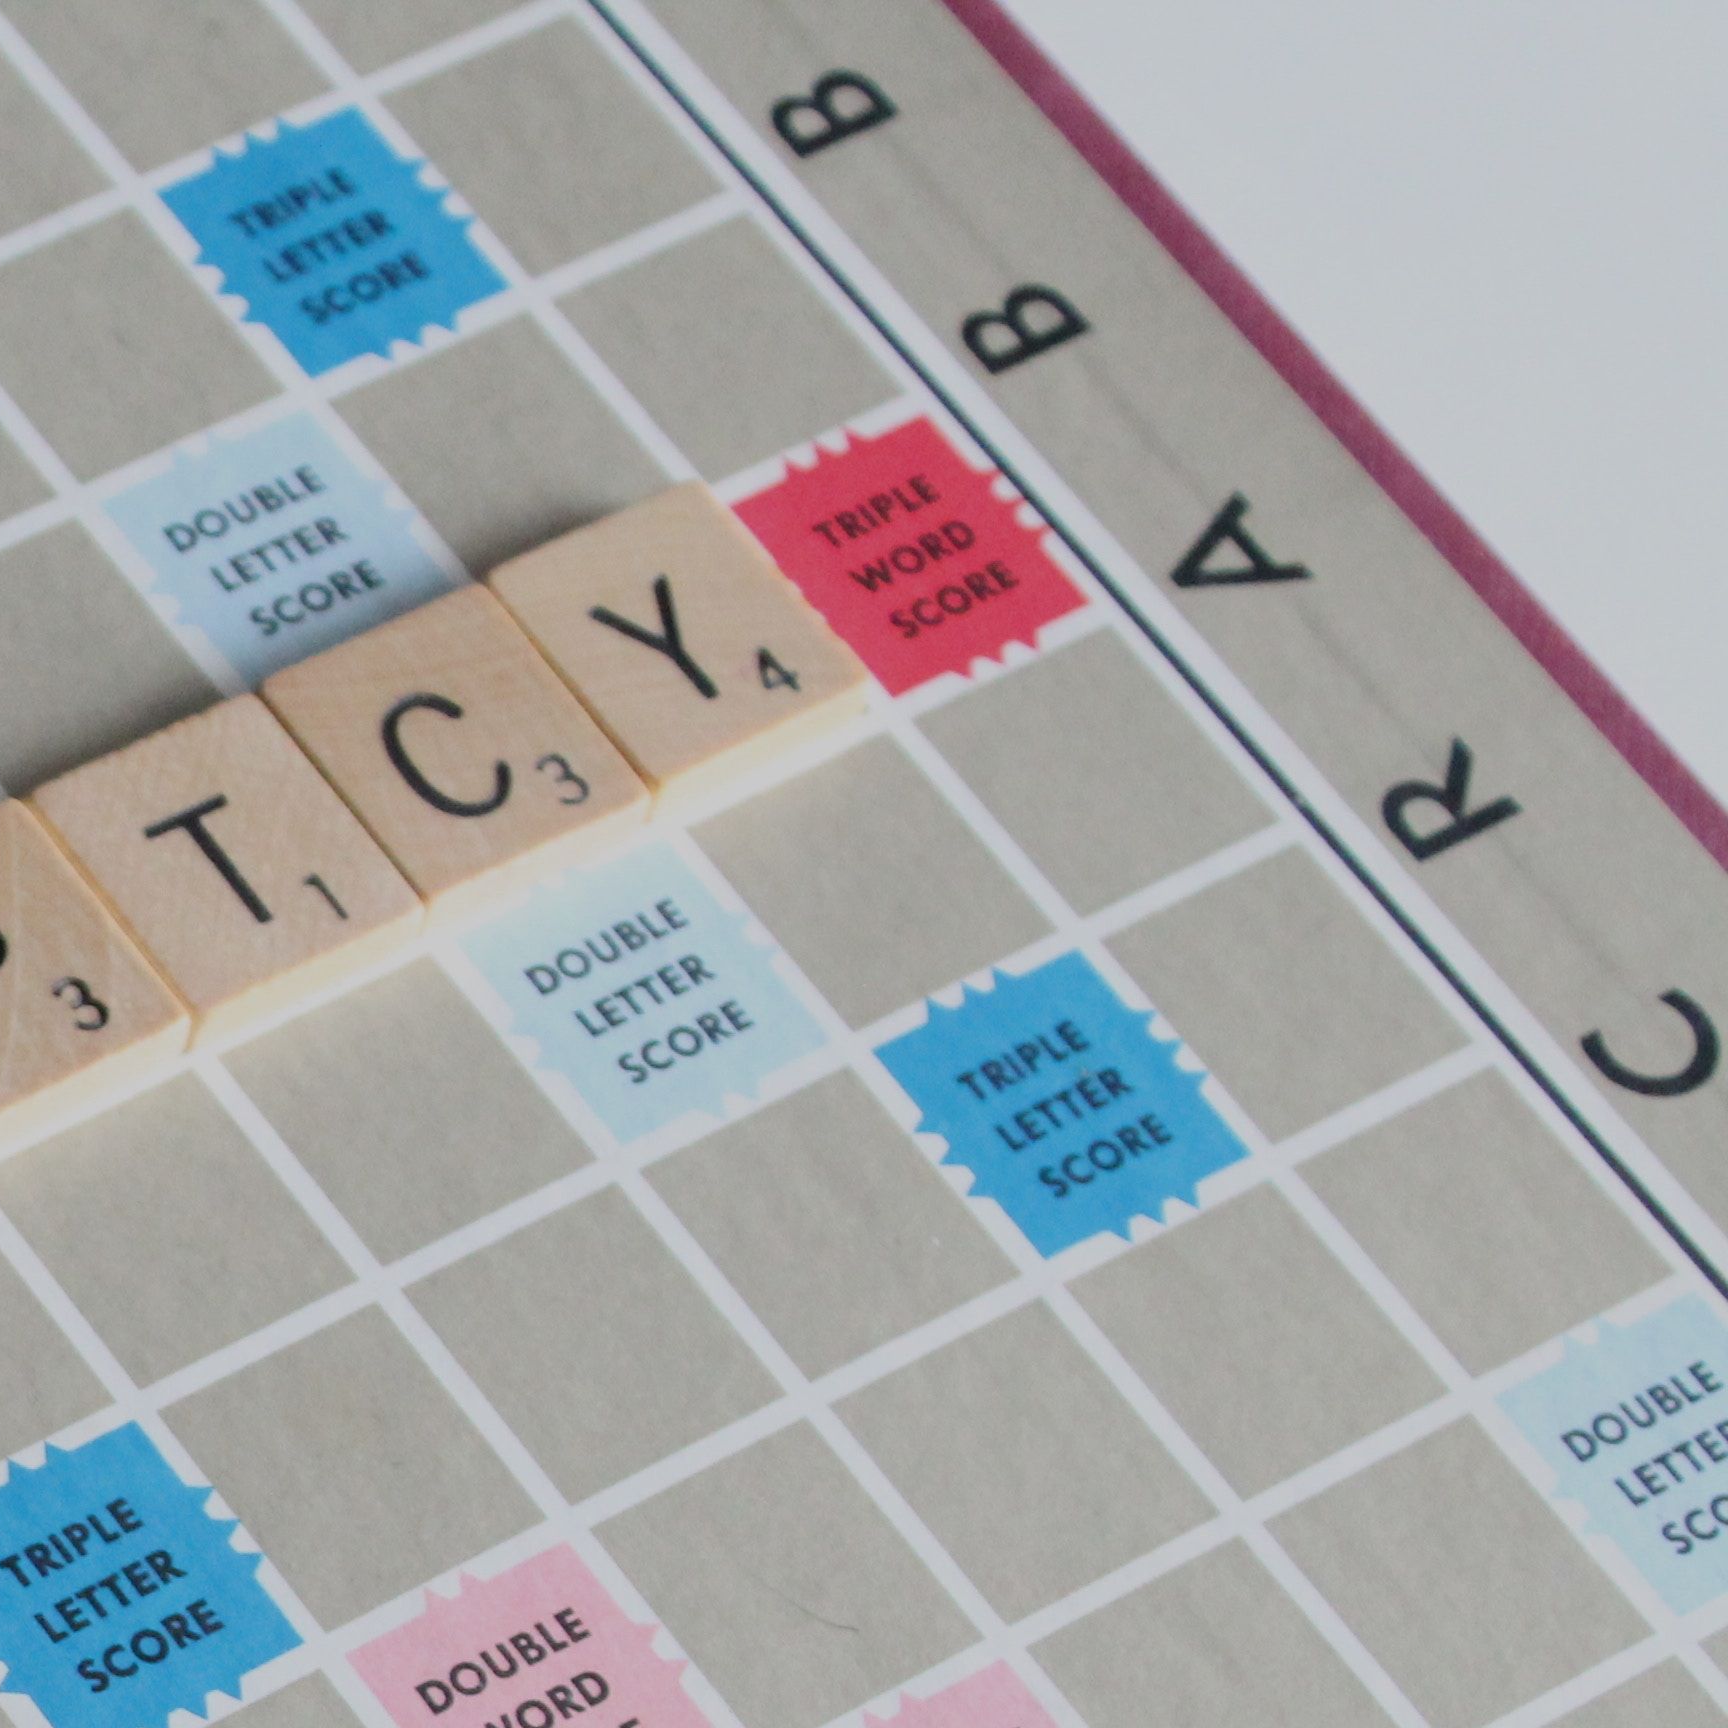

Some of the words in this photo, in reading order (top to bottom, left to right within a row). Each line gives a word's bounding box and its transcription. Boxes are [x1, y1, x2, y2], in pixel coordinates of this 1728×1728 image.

[228, 168, 357, 238] TRIPLE
[262, 210, 394, 284] LETTER
[298, 252, 431, 326] SCORE
[162, 465, 323, 555] DOUBLE
[810, 474, 941, 549] TRIPLE
[209, 517, 349, 594] LETTER
[847, 520, 976, 594] WORD
[248, 560, 384, 639] SCORE
[888, 560, 1020, 641] SCORE
[523, 899, 688, 997] DOUBLE
[573, 953, 715, 1039] LETTER
[616, 999, 754, 1086] SCORE
[954, 1019, 1091, 1102] TRIPLE
[993, 1067, 1135, 1154] LETTER
[1036, 1113, 1175, 1200] SCORE
[1559, 1360, 1724, 1464] DOUBLE
[32, 1549, 189, 1645] LETTER
[75, 1598, 226, 1695] SCORE
[413, 1606, 592, 1717] DOUBLE
